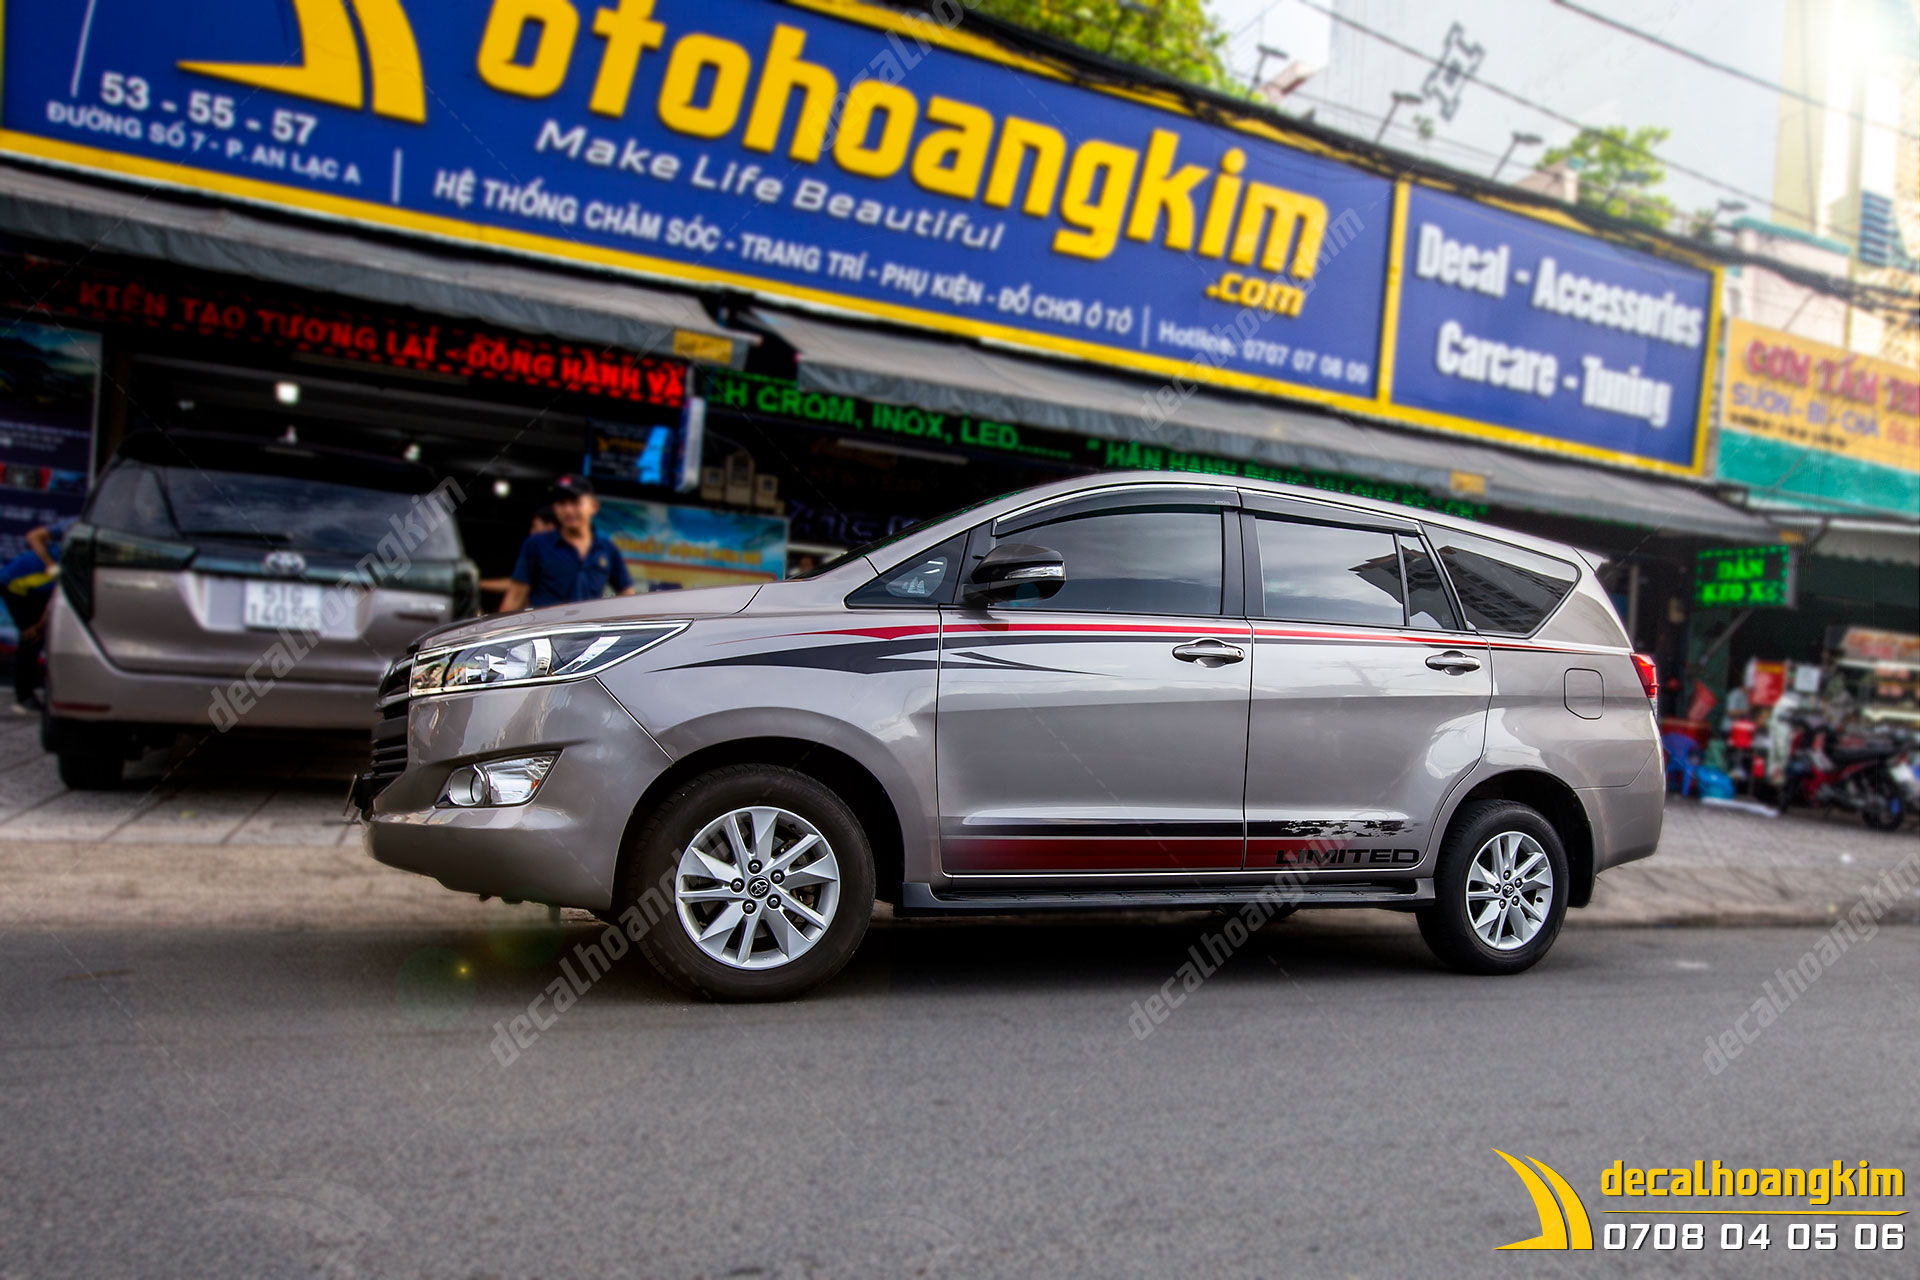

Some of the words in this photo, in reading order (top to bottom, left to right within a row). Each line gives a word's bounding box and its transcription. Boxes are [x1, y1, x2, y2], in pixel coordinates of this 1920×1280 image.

[101, 71, 150, 111] 53
[188, 90, 235, 128] 55
[272, 109, 317, 145] 57
[191, 131, 206, 153] 7
[252, 145, 285, 169] AN
[291, 153, 338, 179] LẠC
[344, 165, 361, 185] A
[534, 118, 681, 181] Make
[691, 154, 783, 204] Life
[792, 178, 1006, 252] Beautiful
[433, 168, 476, 208] HỆ
[482, 177, 577, 224] THỐNG
[666, 216, 721, 252] SÓC
[740, 233, 821, 271] TRANG
[827, 251, 868, 281] TRÍ
[881, 262, 928, 297] PHỤ
[931, 273, 985, 306] KIỆN
[1104, 307, 1133, 335] TÔ
[1416, 222, 1509, 298] Decal
[1531, 256, 1703, 348] Accessories
[1436, 319, 1557, 397] Carcare
[1582, 354, 1672, 430] Tuning
[1276, 849, 1420, 864] LIMITED
